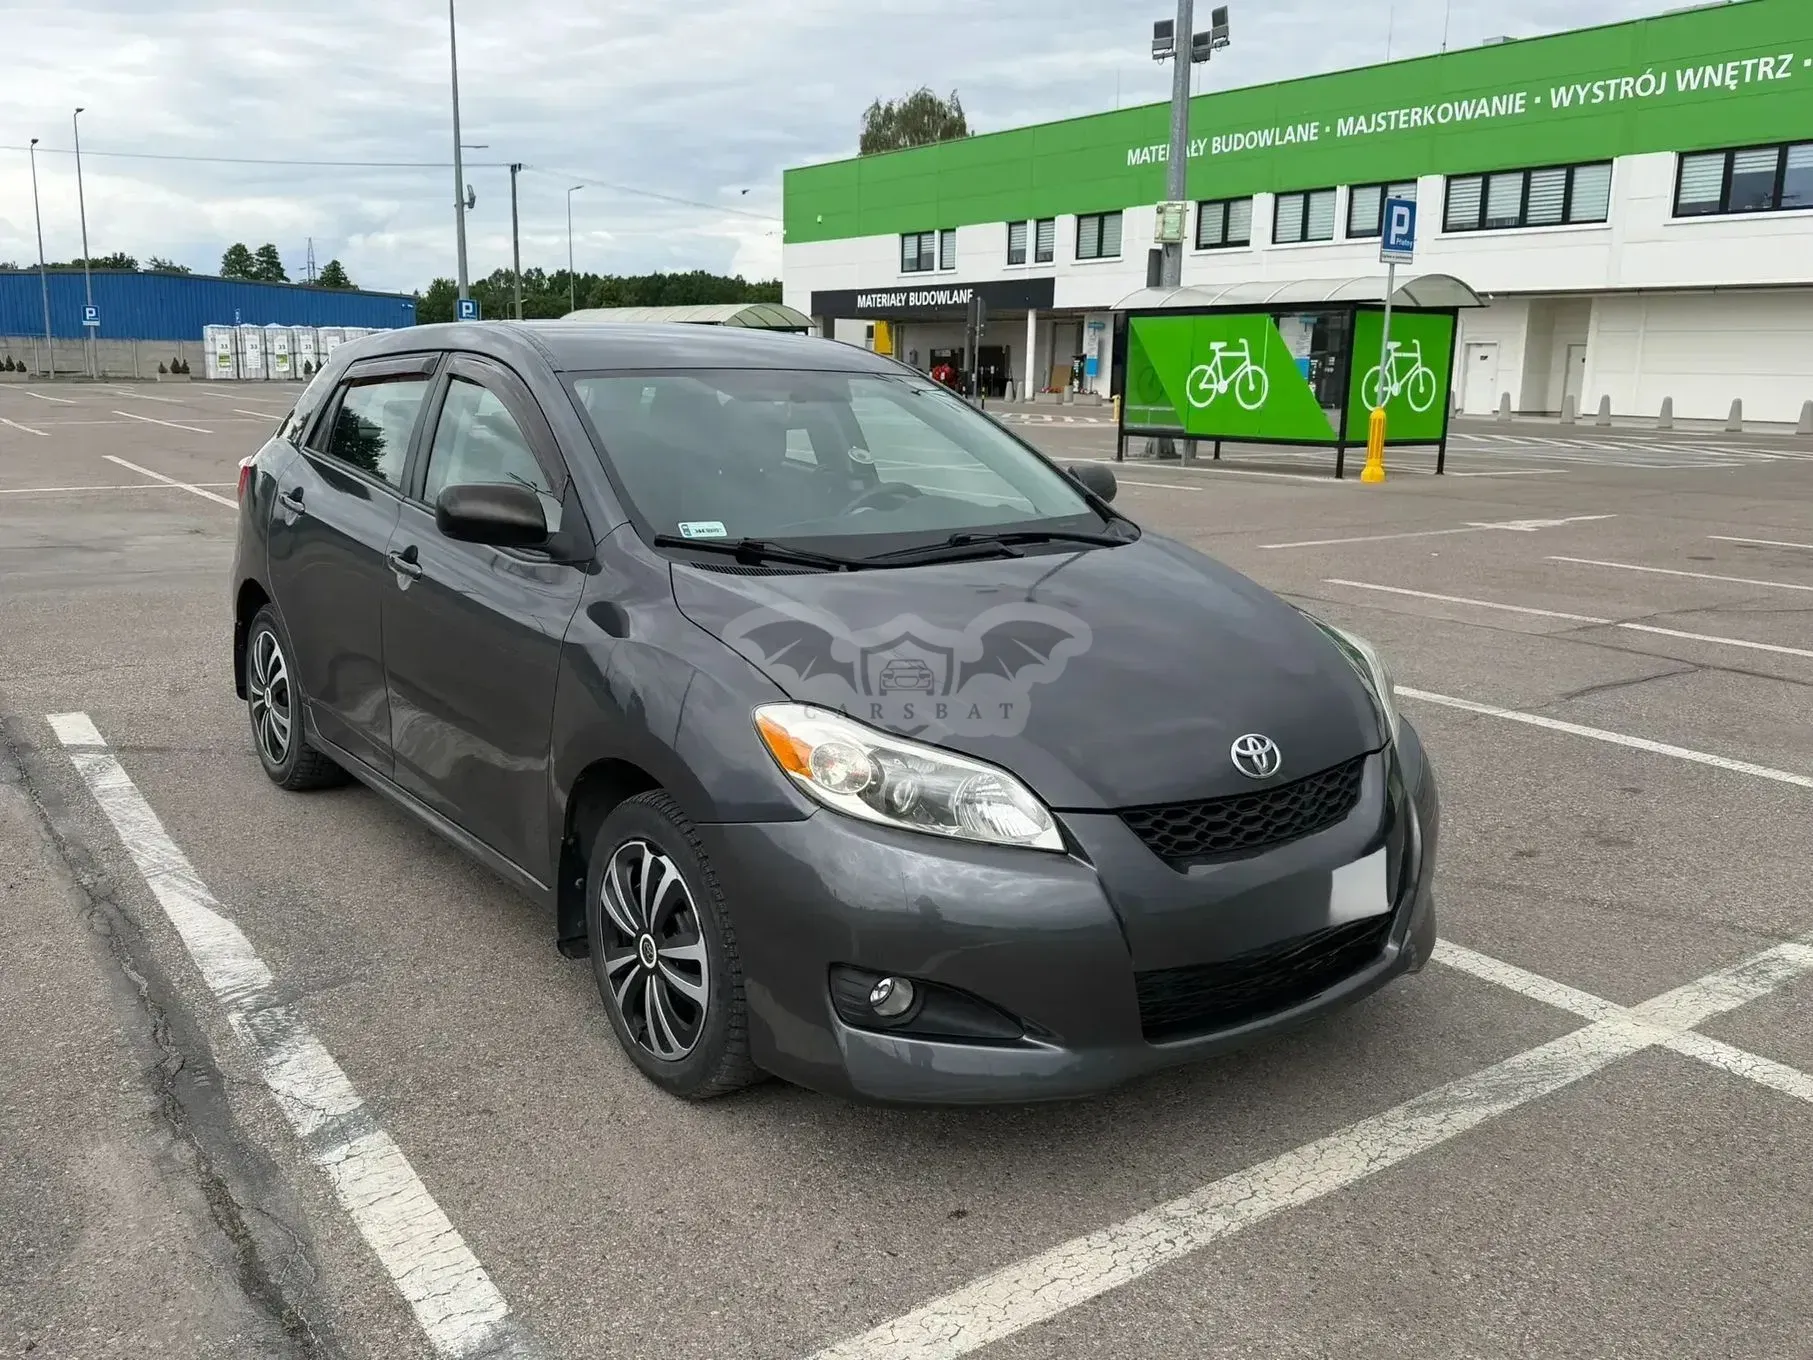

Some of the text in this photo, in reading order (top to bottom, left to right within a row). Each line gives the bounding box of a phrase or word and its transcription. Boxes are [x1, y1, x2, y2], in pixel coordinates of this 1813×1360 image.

[1127, 53, 1794, 166] MATEŁY BUDOWLANE MAJSTERKOWANIE WYSTRÓJ WNĘTRZ
[1390, 205, 1410, 245] P
[857, 292, 907, 308] MATERIAŁY
[85, 307, 96, 320] P
[461, 301, 473, 318] P
